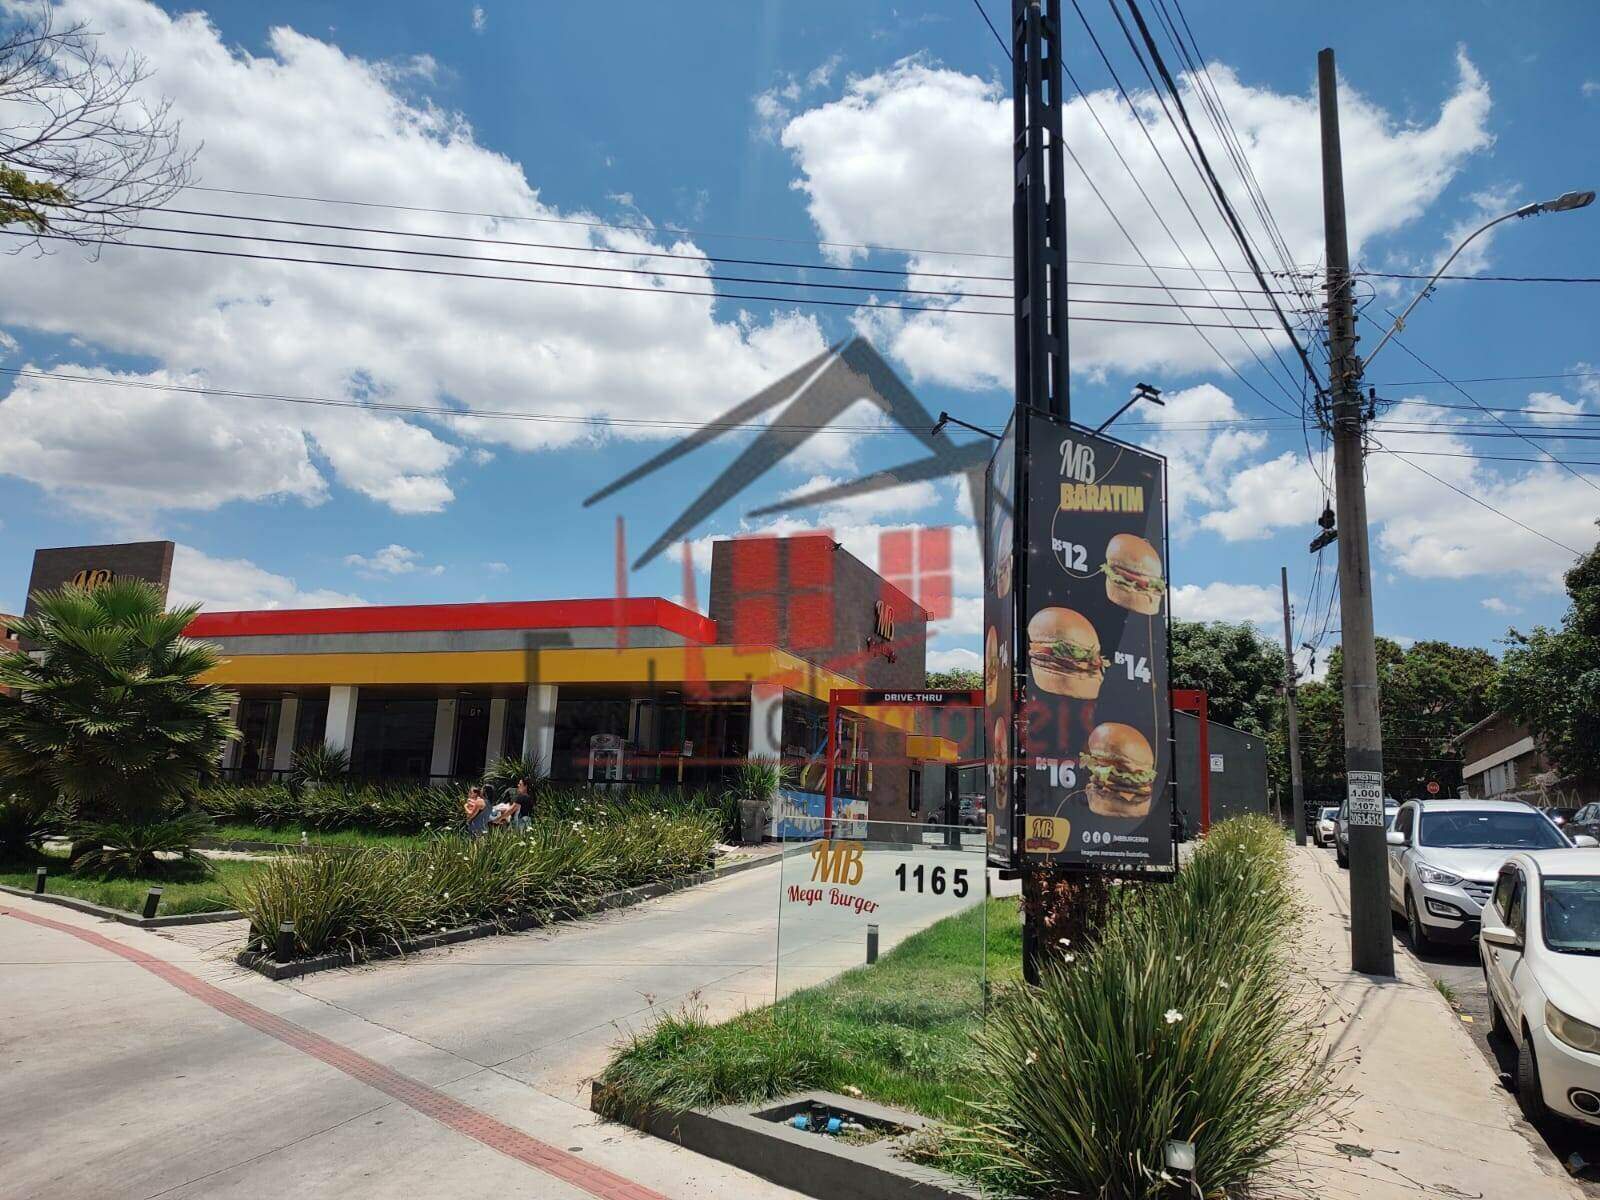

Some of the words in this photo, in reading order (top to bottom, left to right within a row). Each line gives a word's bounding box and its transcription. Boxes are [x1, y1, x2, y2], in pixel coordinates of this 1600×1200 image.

[1059, 439, 1096, 485] MB
[1060, 483, 1144, 513] BARATIM
[884, 693, 943, 702] DRIVE-THRU
[1352, 790, 1380, 798] 1.000
[811, 840, 864, 886] MB
[895, 863, 969, 898] 1165
[788, 885, 823, 907] Mega
[829, 887, 879, 914] Burger
